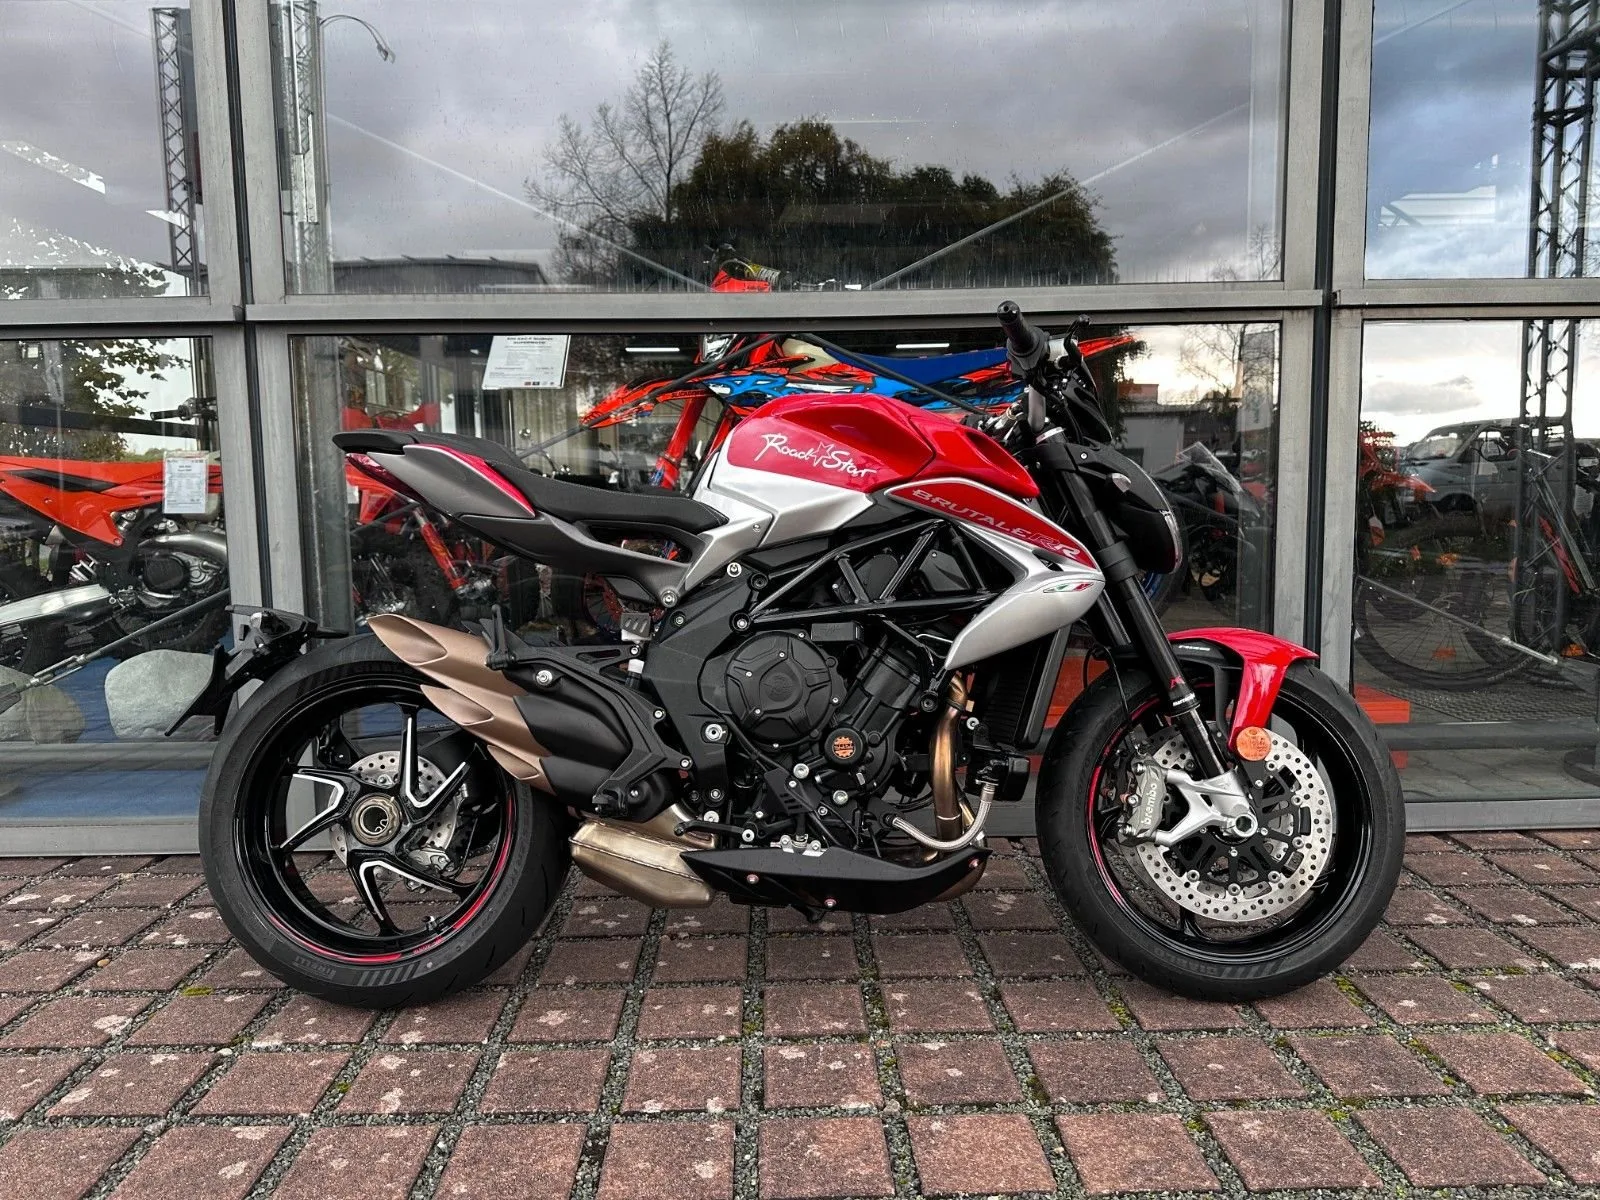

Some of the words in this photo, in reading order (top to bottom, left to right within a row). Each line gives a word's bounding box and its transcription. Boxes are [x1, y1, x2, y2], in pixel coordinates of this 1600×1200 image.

[754, 433, 815, 462] Road
[822, 450, 877, 478] Star
[912, 489, 1032, 538] BRUTALE
[1140, 782, 1158, 826] brembo
[292, 955, 337, 980] PIRELLI
